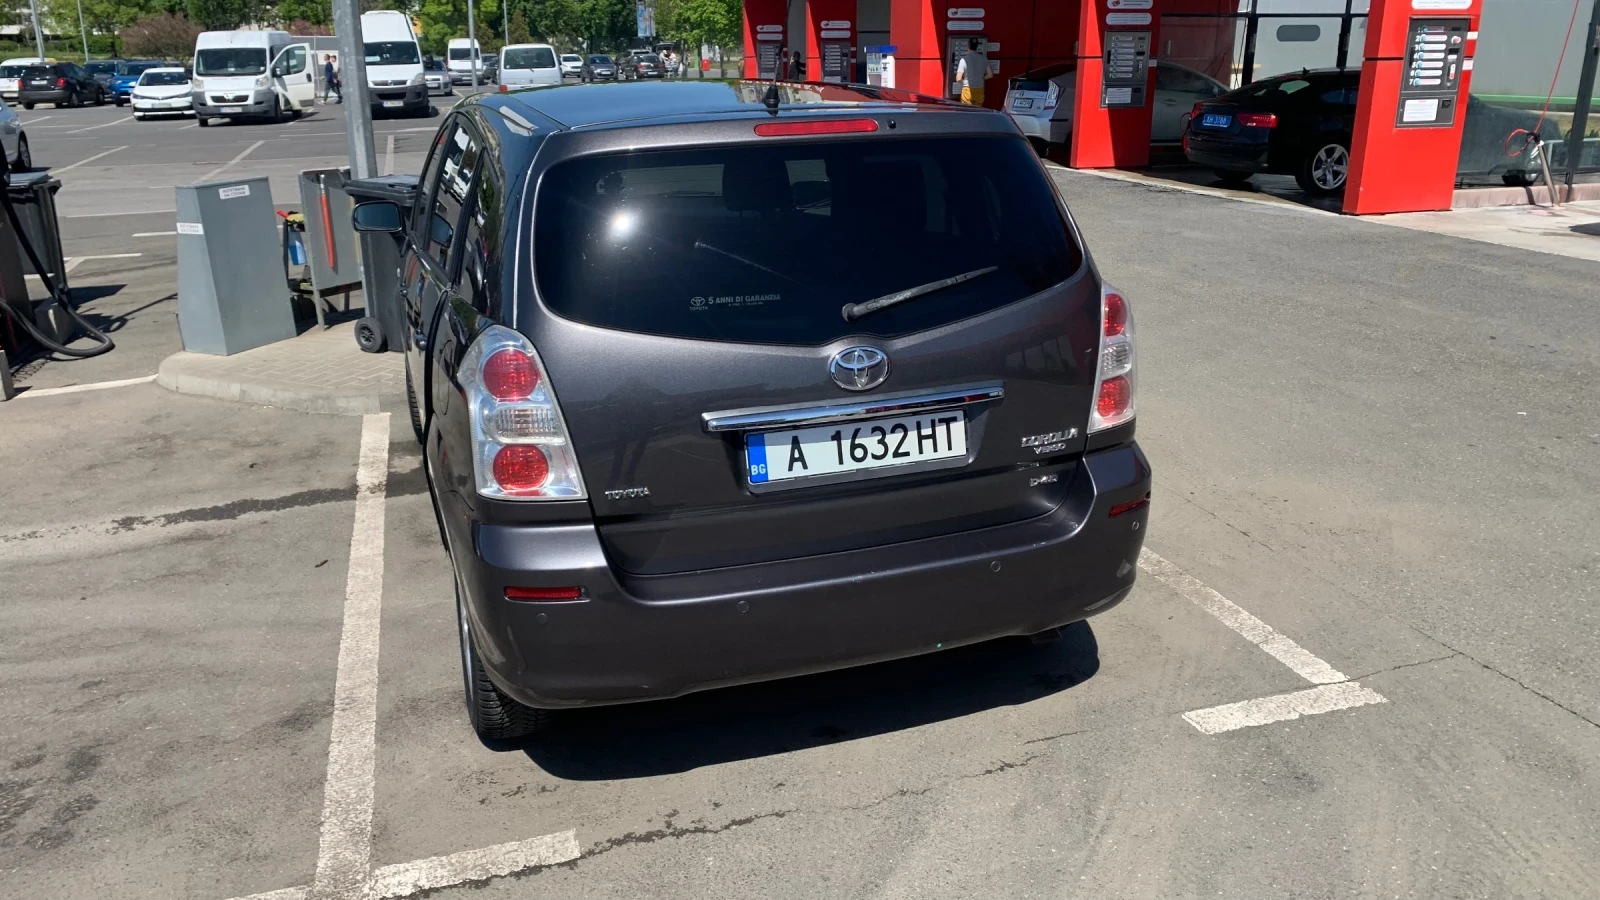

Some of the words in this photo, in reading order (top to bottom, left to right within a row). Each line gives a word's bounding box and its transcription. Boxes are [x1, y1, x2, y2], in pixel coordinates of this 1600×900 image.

[708, 296, 714, 305] 5
[715, 296, 734, 304] ANNI
[735, 295, 744, 303] DI
[745, 293, 781, 302] GARANZIA
[1021, 427, 1078, 448] COROLLA
[788, 435, 809, 472] A
[751, 463, 767, 476] BG
[604, 486, 651, 500] TOYOTA
